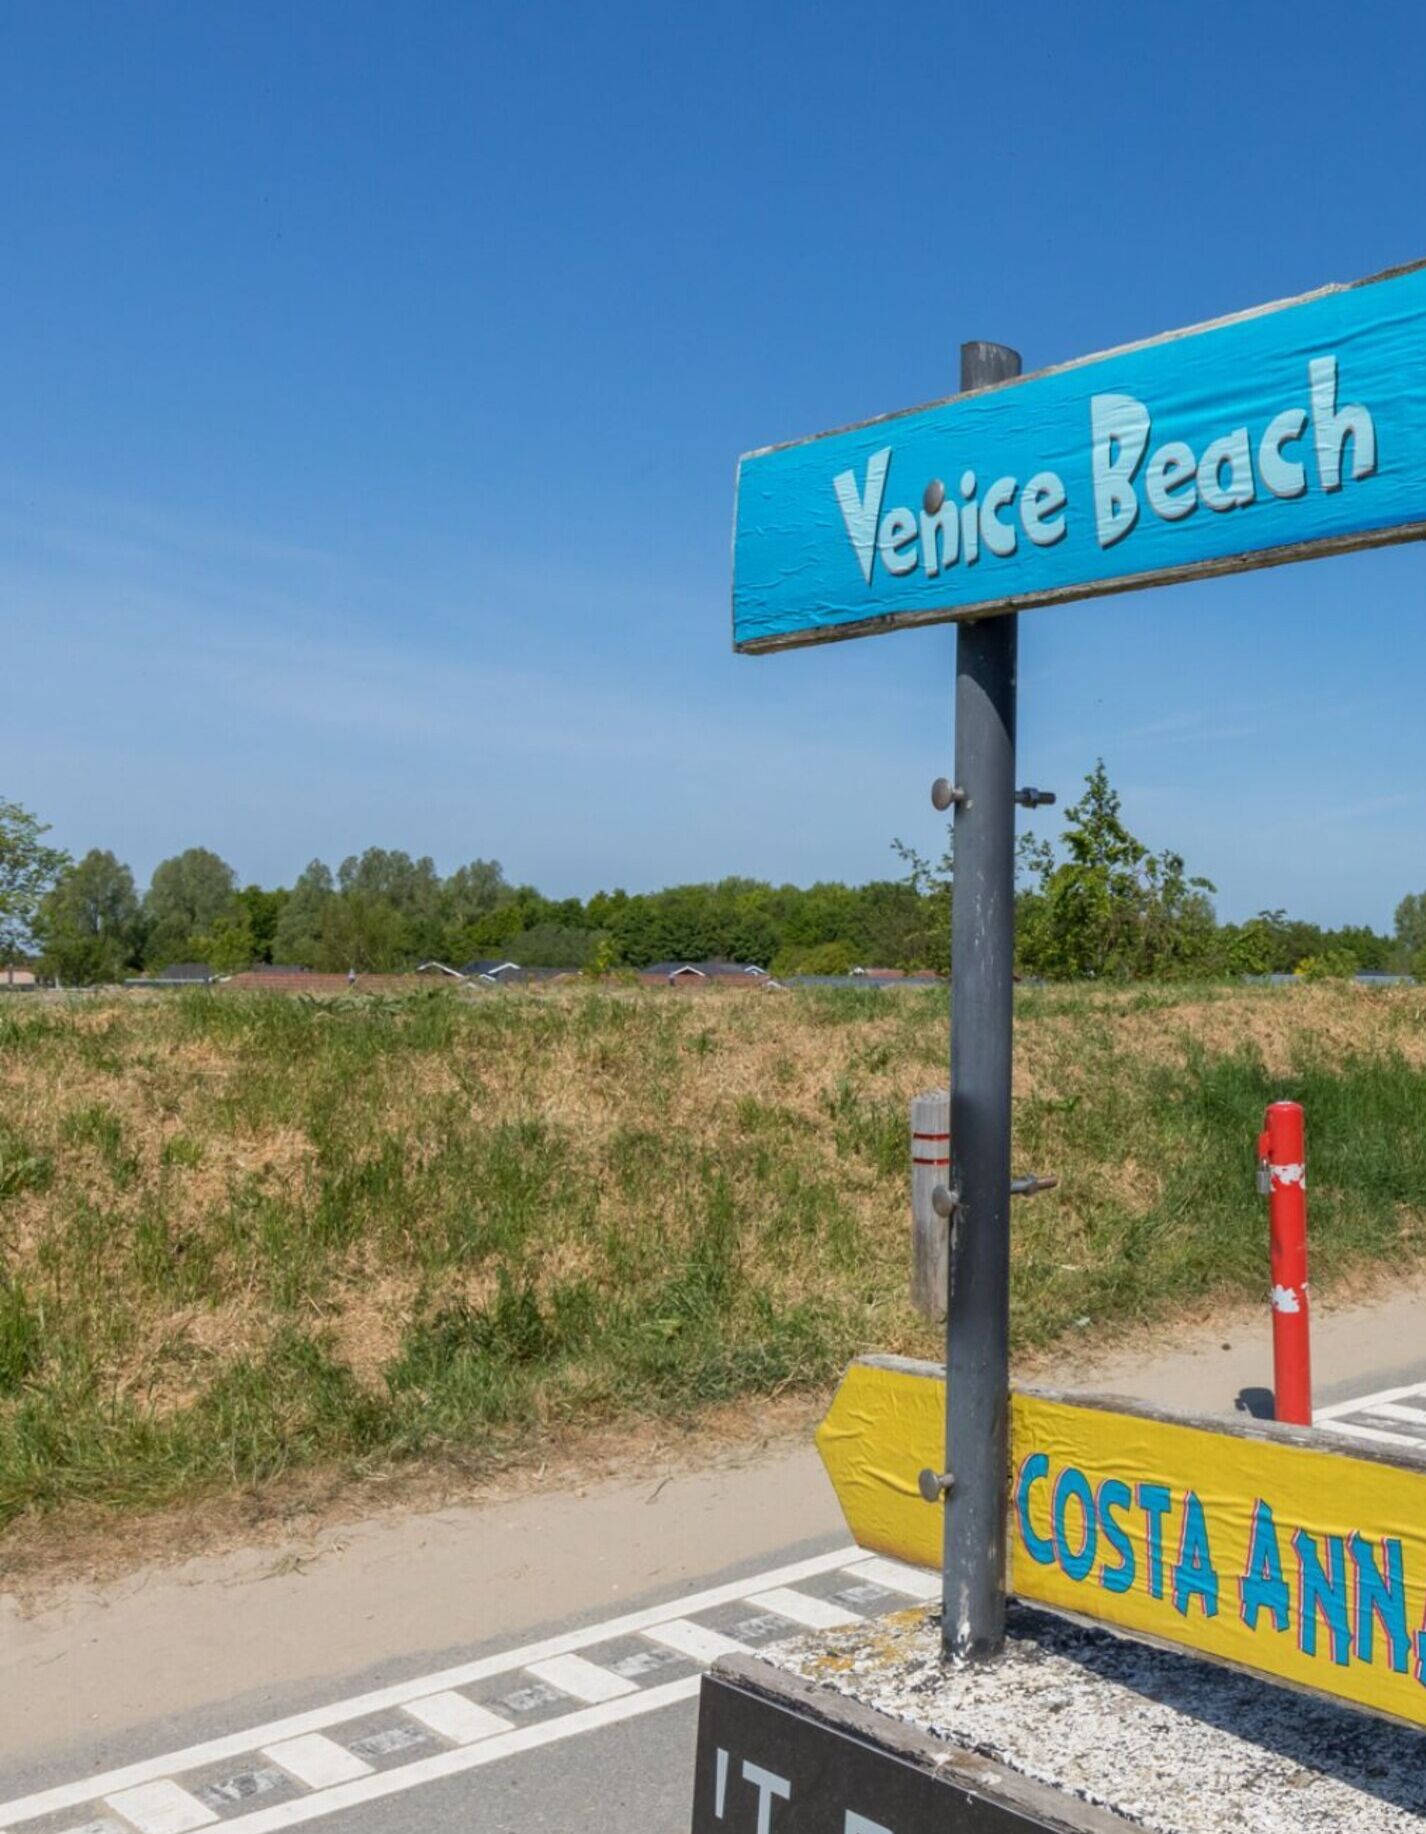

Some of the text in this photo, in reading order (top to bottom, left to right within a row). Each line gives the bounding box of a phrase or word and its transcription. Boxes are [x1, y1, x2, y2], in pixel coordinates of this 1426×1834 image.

[834, 446, 1067, 587] Venice
[1091, 355, 1378, 549] Beach
[1015, 1452, 1219, 1618] COSTA
